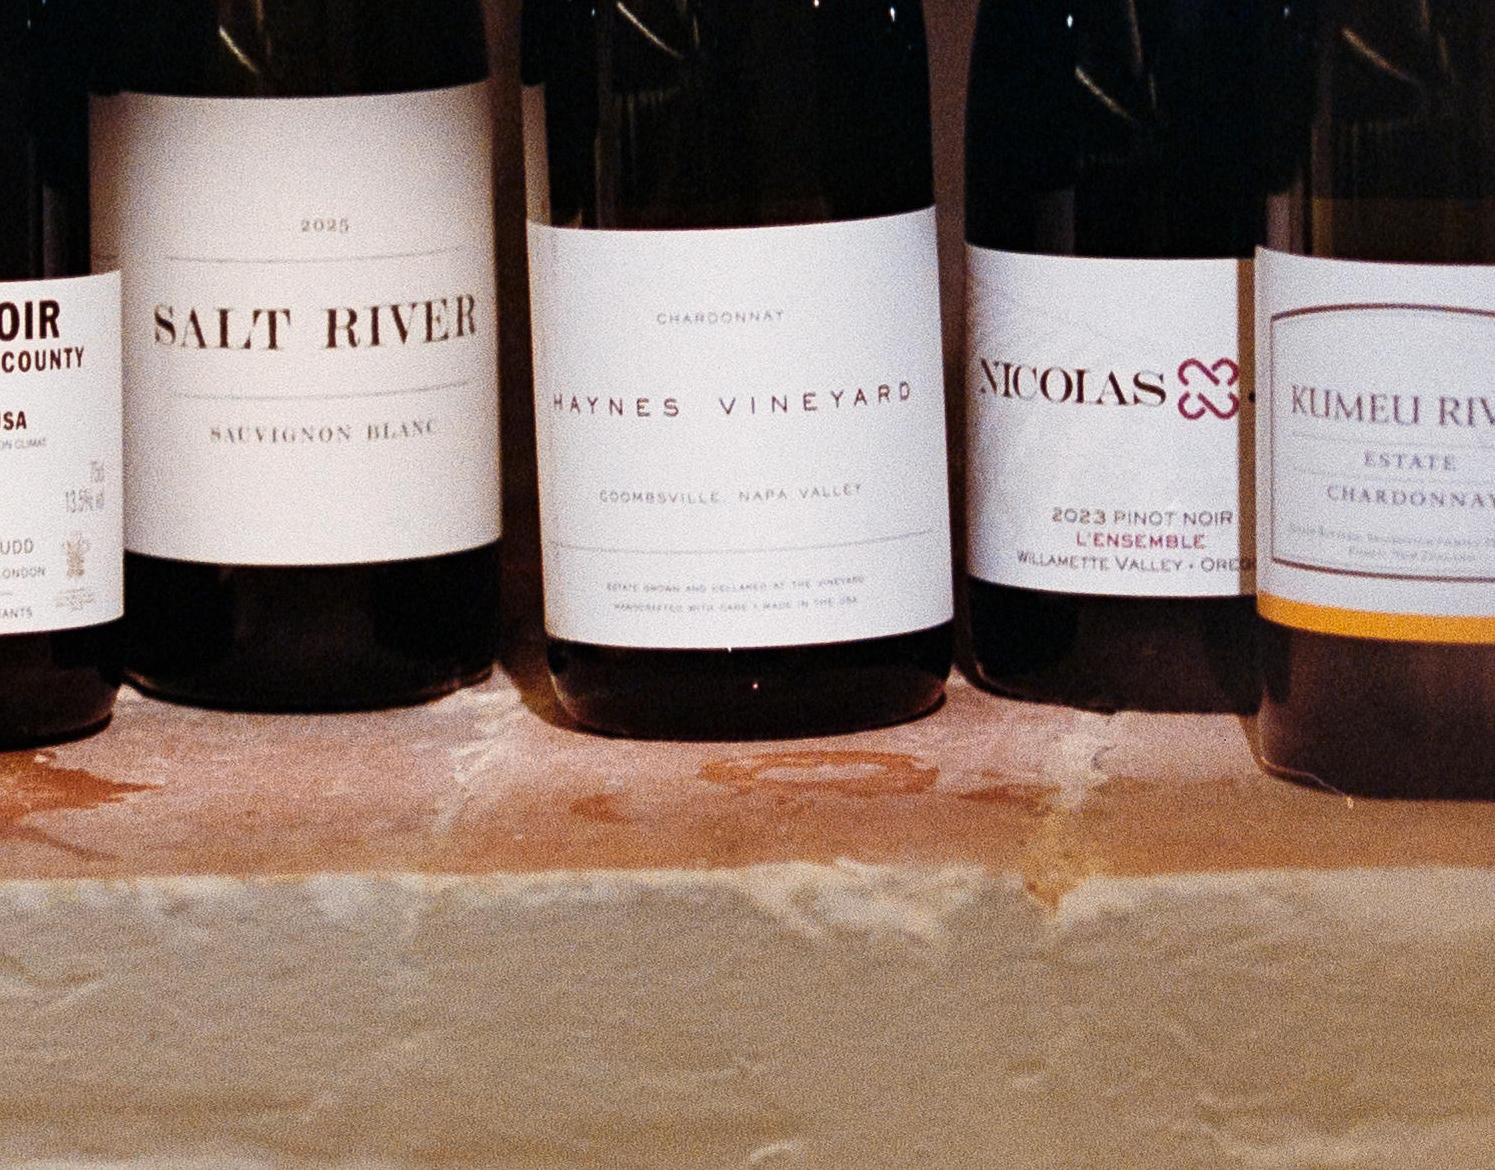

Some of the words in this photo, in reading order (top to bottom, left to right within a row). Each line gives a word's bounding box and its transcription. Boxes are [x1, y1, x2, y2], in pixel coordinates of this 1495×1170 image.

[151, 302, 292, 351] SALT
[322, 292, 477, 350] RIVER
[656, 308, 785, 326] CHARDONNAY
[0, 344, 85, 374] COUNTY
[980, 357, 1167, 407] NICOLAS
[552, 392, 681, 419] HAYNES
[718, 380, 912, 417] VINEYARD
[1291, 384, 1421, 427] KUMEU
[209, 424, 354, 445] SAUVIGNON
[366, 418, 437, 443] BLANC
[1363, 451, 1457, 472] ESTATE
[738, 489, 788, 503] NAPA
[798, 483, 862, 499] VALLEY
[1051, 506, 1107, 526] 2023
[1113, 510, 1176, 527] PINOT
[1183, 510, 1234, 527] NOIR
[1075, 531, 1208, 550] L'ENSEMBLE
[1016, 550, 1110, 572] WILLAMETTE
[1114, 556, 1183, 573] VALLEY
